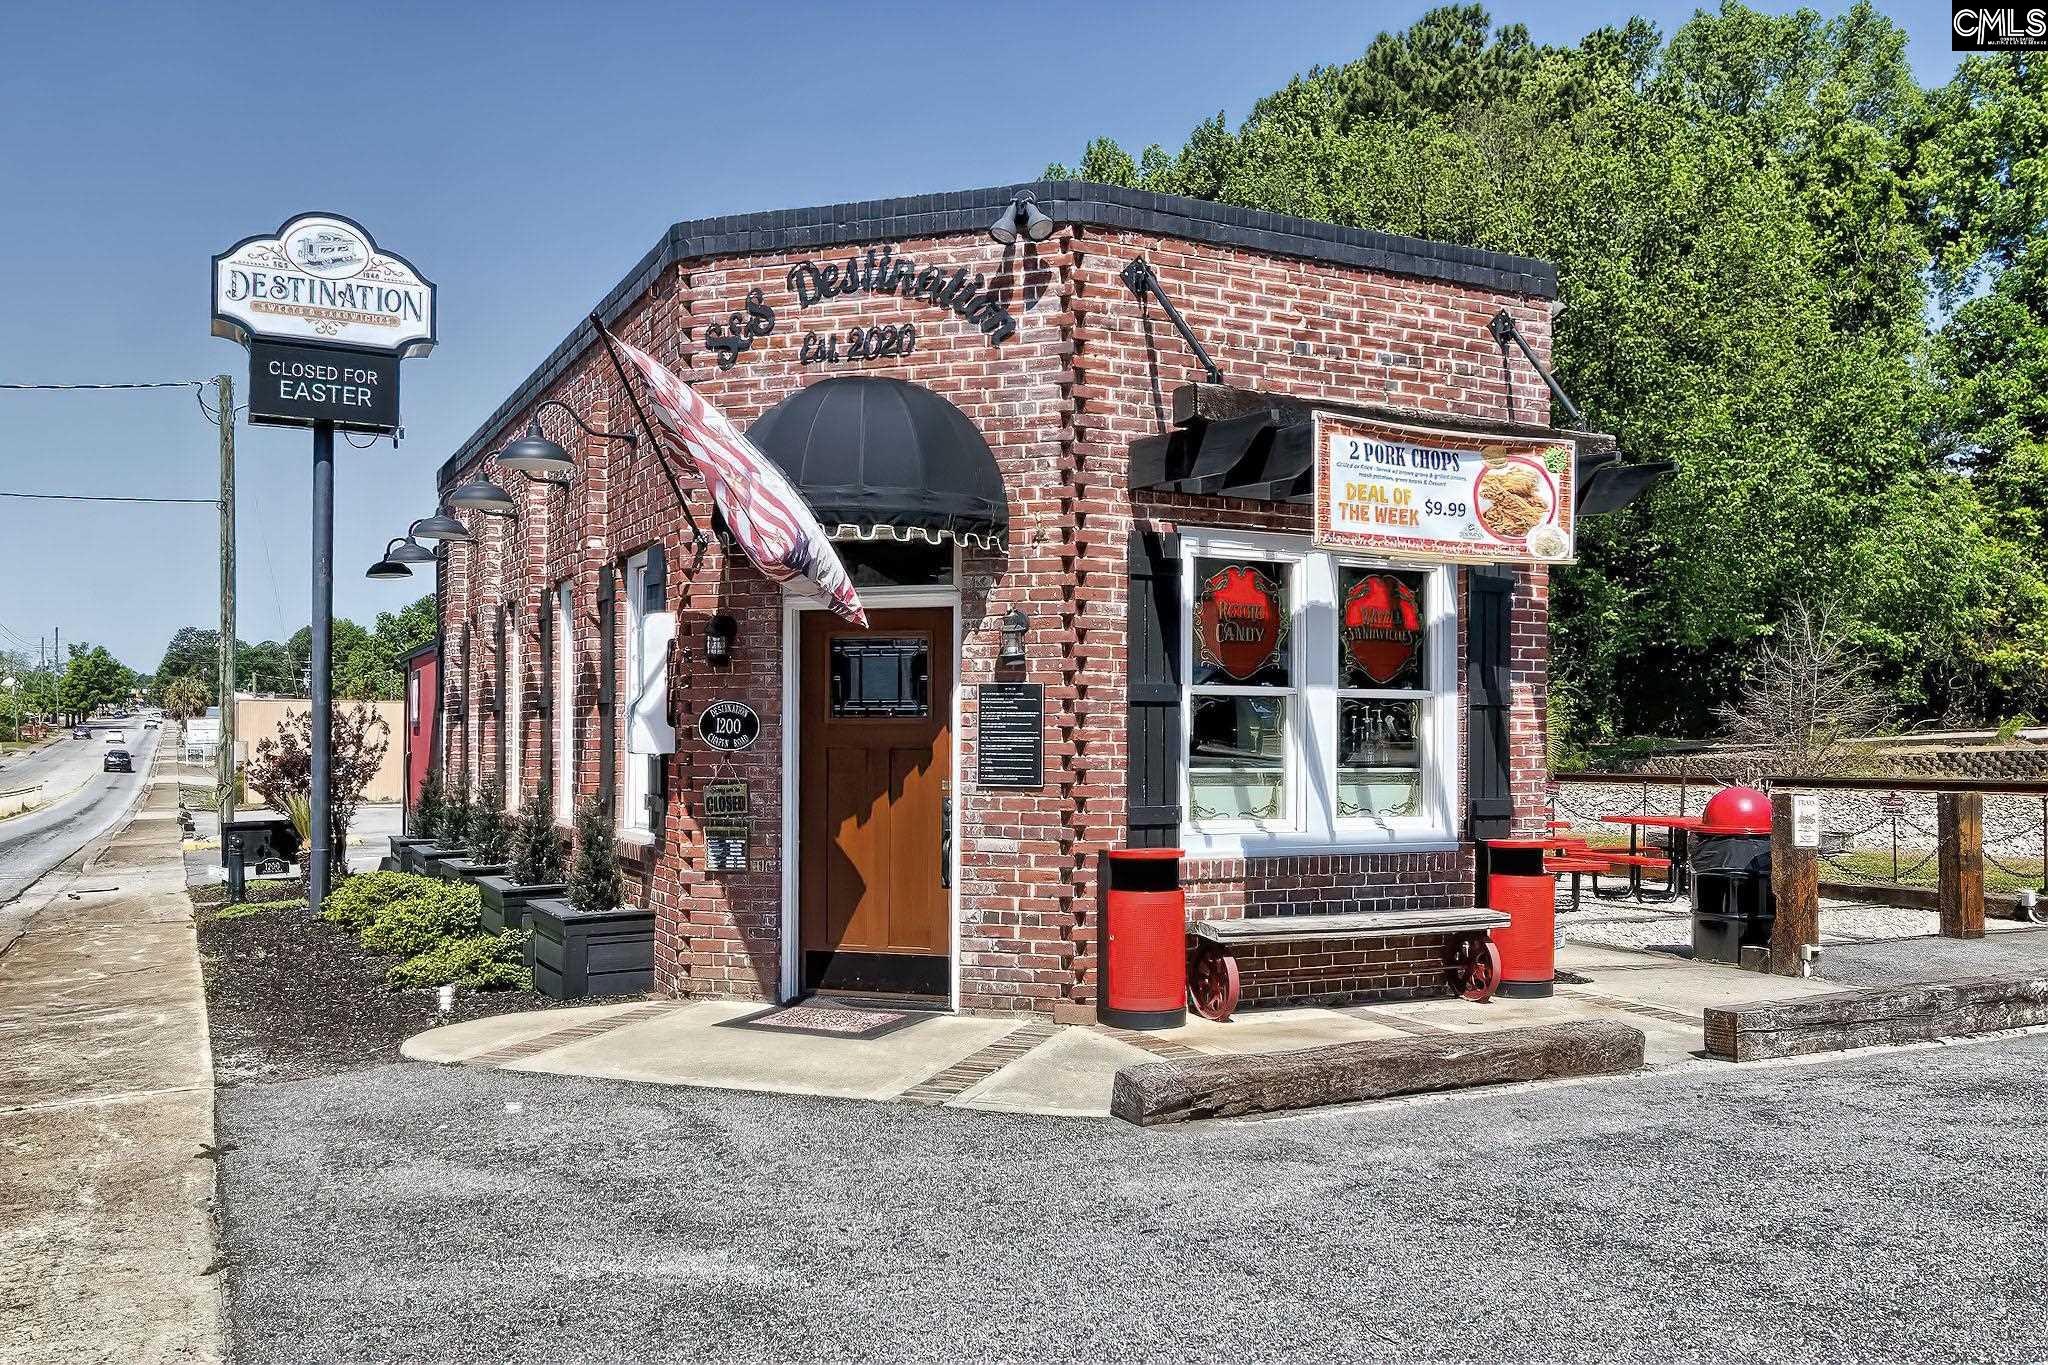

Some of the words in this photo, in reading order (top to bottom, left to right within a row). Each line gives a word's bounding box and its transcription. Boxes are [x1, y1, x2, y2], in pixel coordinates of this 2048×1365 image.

[225, 269, 423, 322] DESTINATION
[787, 246, 1016, 349] Destination
[847, 323, 916, 361] 2020
[269, 360, 338, 381] CLOSED
[344, 367, 378, 386] FOR
[280, 379, 373, 408] EASTER
[1349, 440, 1360, 460] 2
[1363, 442, 1406, 467] PORK
[1411, 448, 1460, 472] CHOPS
[1345, 481, 1389, 504] DEAL
[1393, 487, 1412, 505] OF
[1338, 501, 1370, 523] THE
[1375, 505, 1420, 527] WEEK
[1424, 498, 1466, 518] $9.99
[715, 717, 742, 734] 1200
[705, 795, 746, 812] CLOSED
